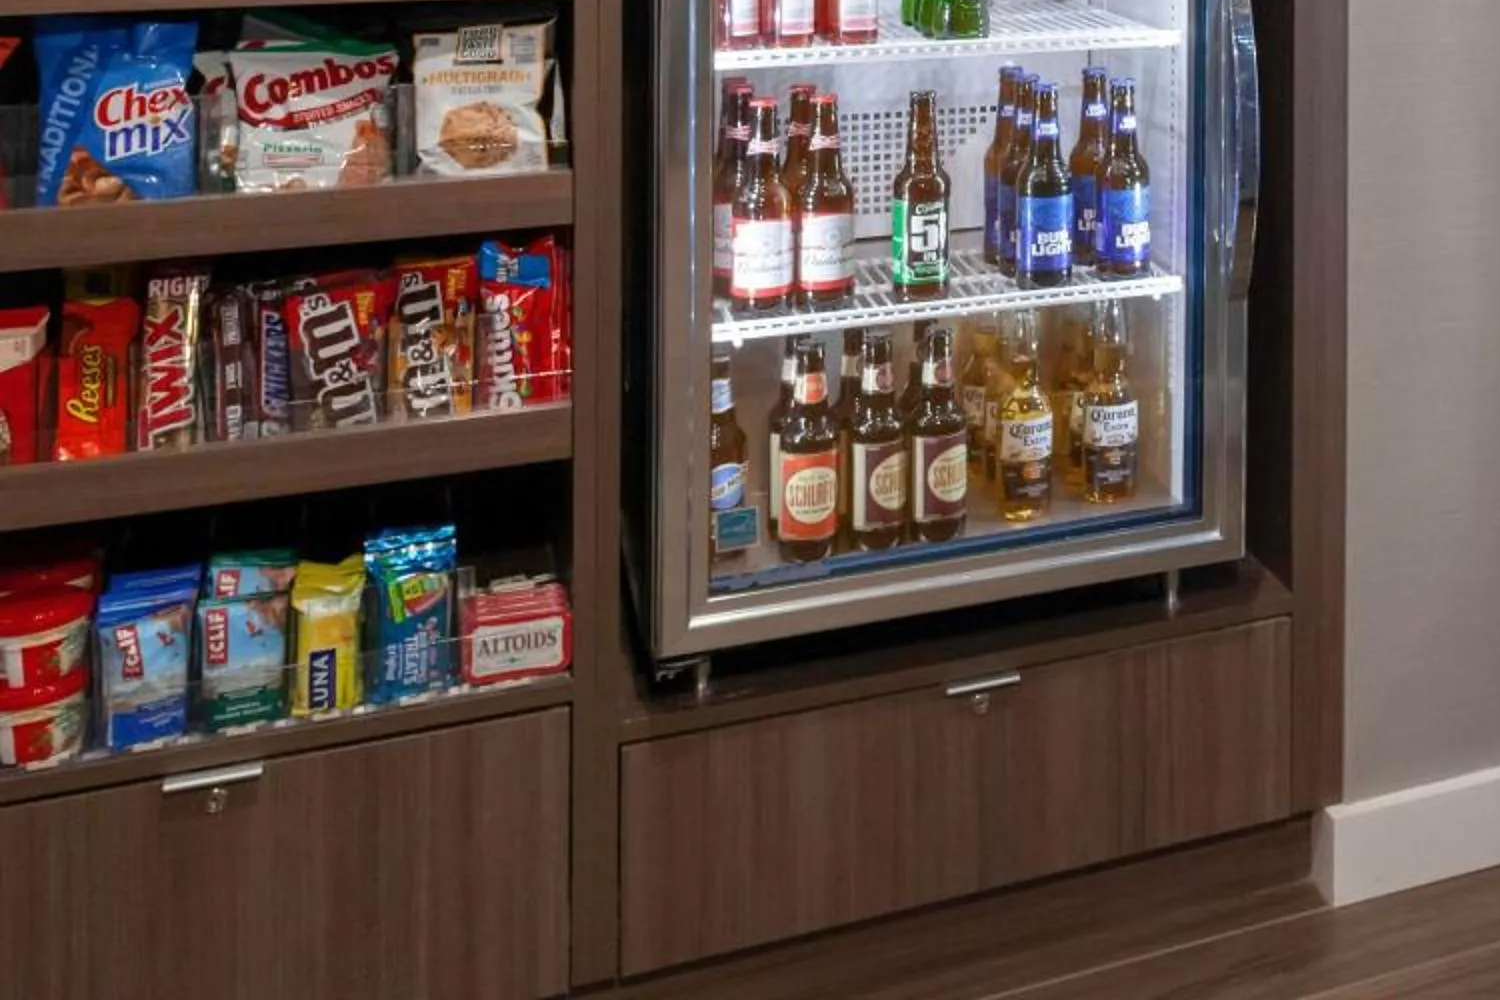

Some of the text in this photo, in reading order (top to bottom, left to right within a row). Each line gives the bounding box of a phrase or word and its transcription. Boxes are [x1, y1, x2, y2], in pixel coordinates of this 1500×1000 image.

[96, 84, 190, 128] Chex
[244, 54, 394, 114] Combos
[109, 107, 189, 158] mix
[1031, 240, 1072, 256] LIGHT
[148, 274, 211, 298] RIGHT
[138, 304, 197, 452] TWIX
[476, 628, 558, 661] ALTOIDS
